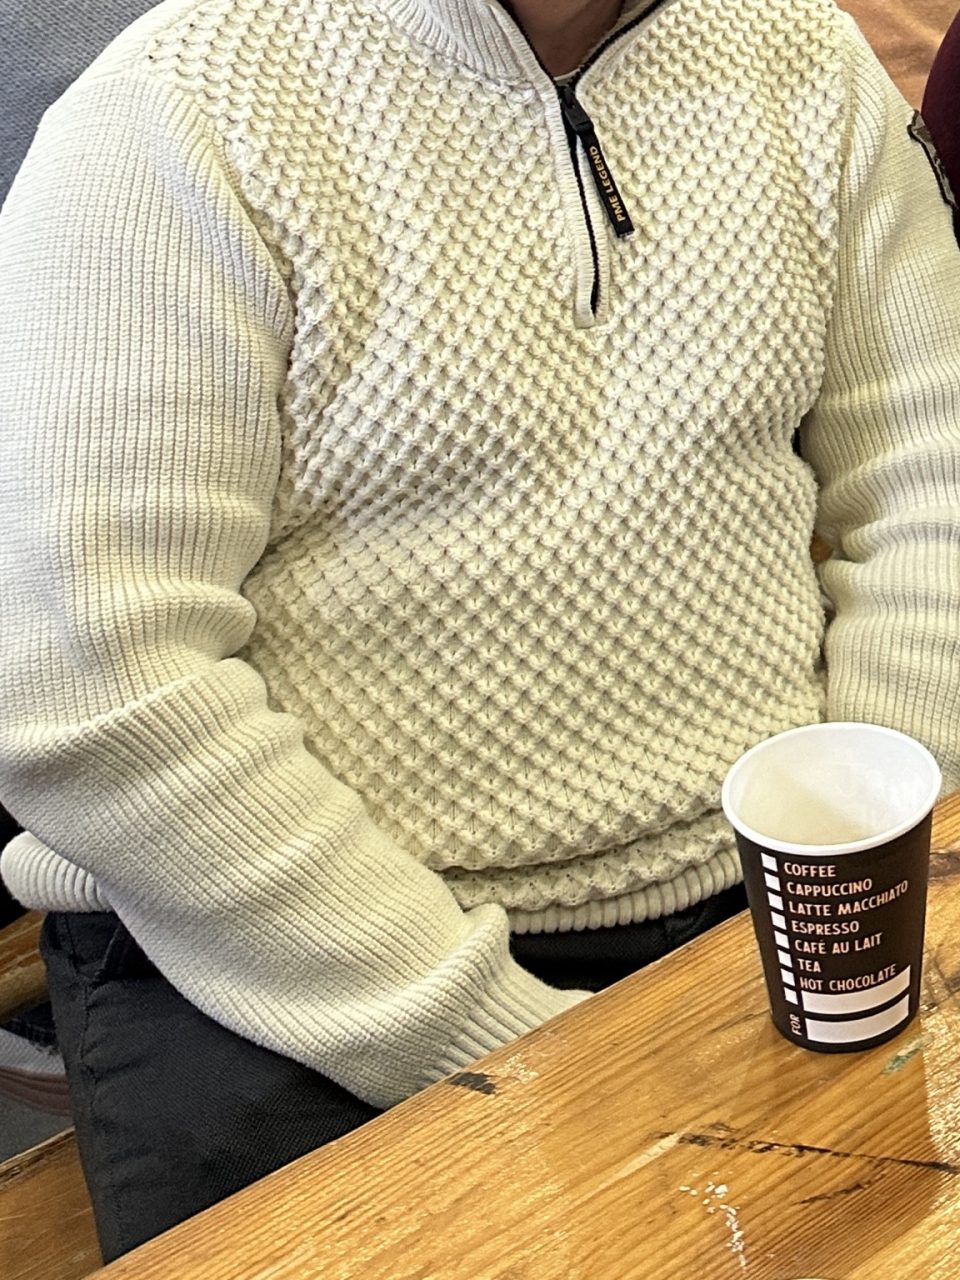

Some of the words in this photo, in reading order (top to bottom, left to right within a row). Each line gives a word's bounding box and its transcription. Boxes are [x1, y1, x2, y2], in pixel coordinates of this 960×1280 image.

[589, 145, 614, 194] LEGEND
[608, 194, 626, 222] PME
[784, 862, 836, 877] COFFEE
[786, 878, 872, 896] CAPPUCCINO
[788, 900, 832, 916] LATTE
[838, 880, 908, 915] MACCHIATO
[792, 920, 859, 935] ESPRESSO
[795, 939, 827, 954] CAFÉ
[832, 941, 850, 954] AU
[854, 932, 882, 951] LAIT
[797, 958, 821, 972] TEA
[800, 976, 822, 991] HOT
[829, 963, 897, 991] CHOCOLATE
[789, 1013, 802, 1035] FOR
